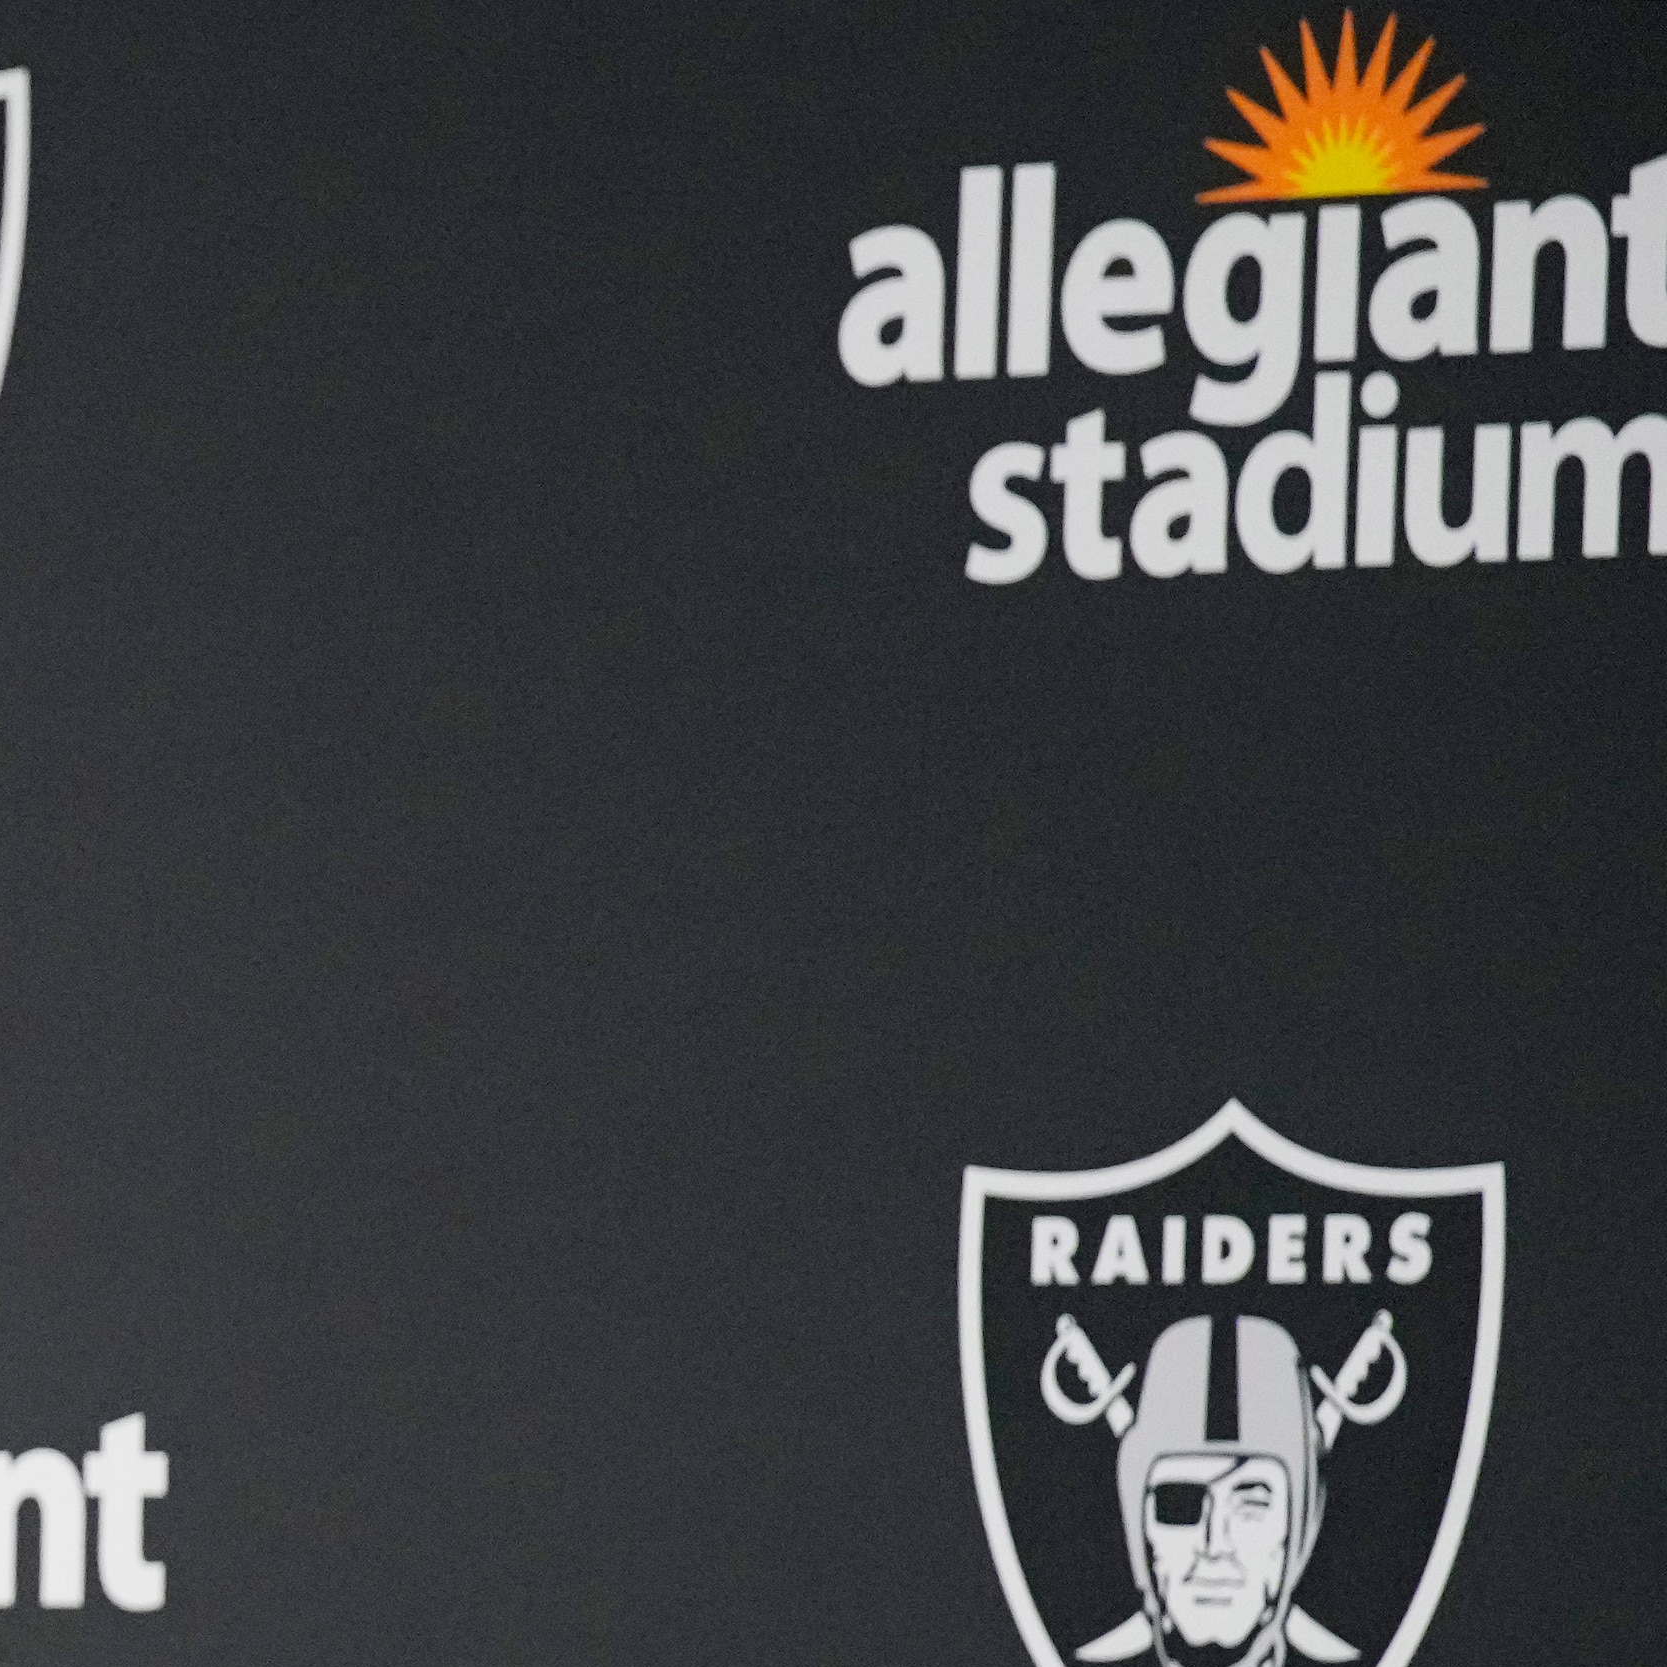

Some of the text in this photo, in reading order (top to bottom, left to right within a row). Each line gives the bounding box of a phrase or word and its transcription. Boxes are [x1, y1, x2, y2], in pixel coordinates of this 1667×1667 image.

[837, 155, 1667, 426] allegiant
[964, 370, 1667, 584] stadium
[1030, 1210, 1433, 1287] RAIDERS
